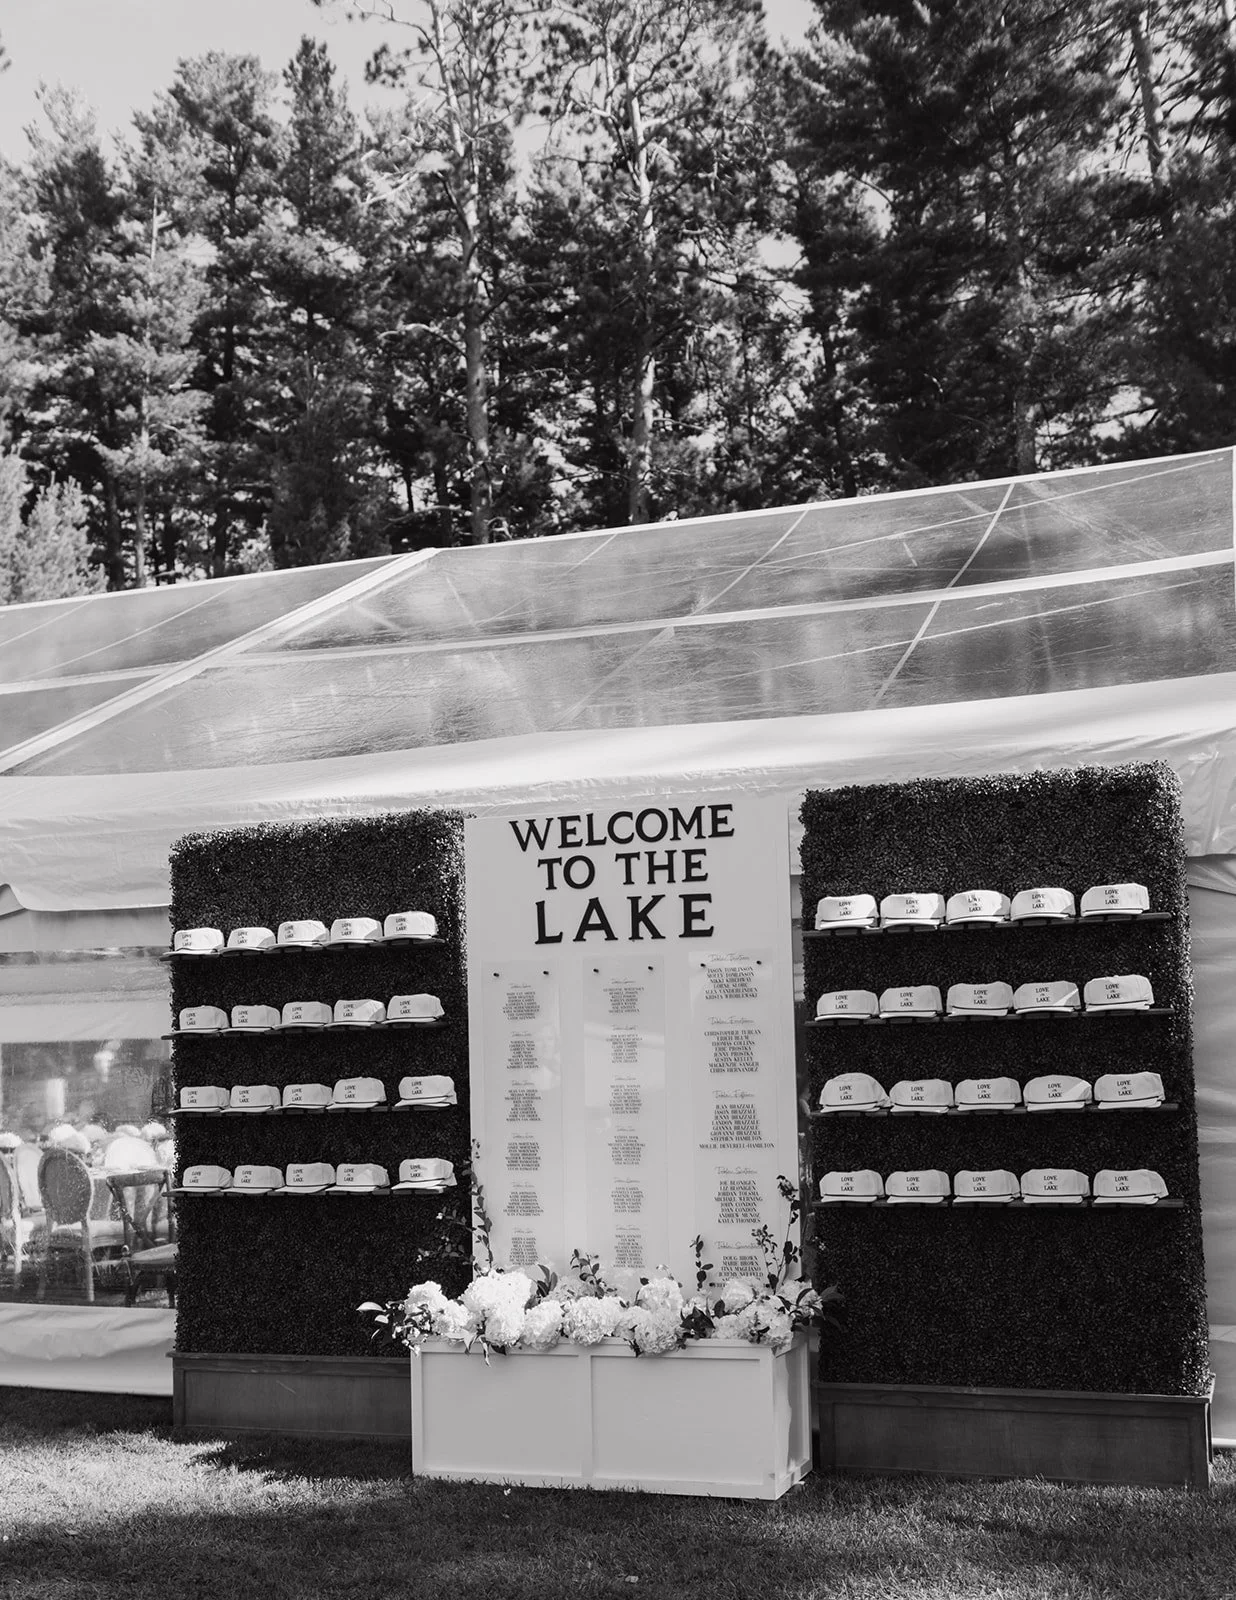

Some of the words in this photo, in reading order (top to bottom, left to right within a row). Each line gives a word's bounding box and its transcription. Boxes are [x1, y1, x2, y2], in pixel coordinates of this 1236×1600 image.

[509, 803, 735, 852] WELCOME
[537, 854, 596, 891] TO
[615, 848, 709, 886] THE
[535, 893, 715, 945] LAKE
